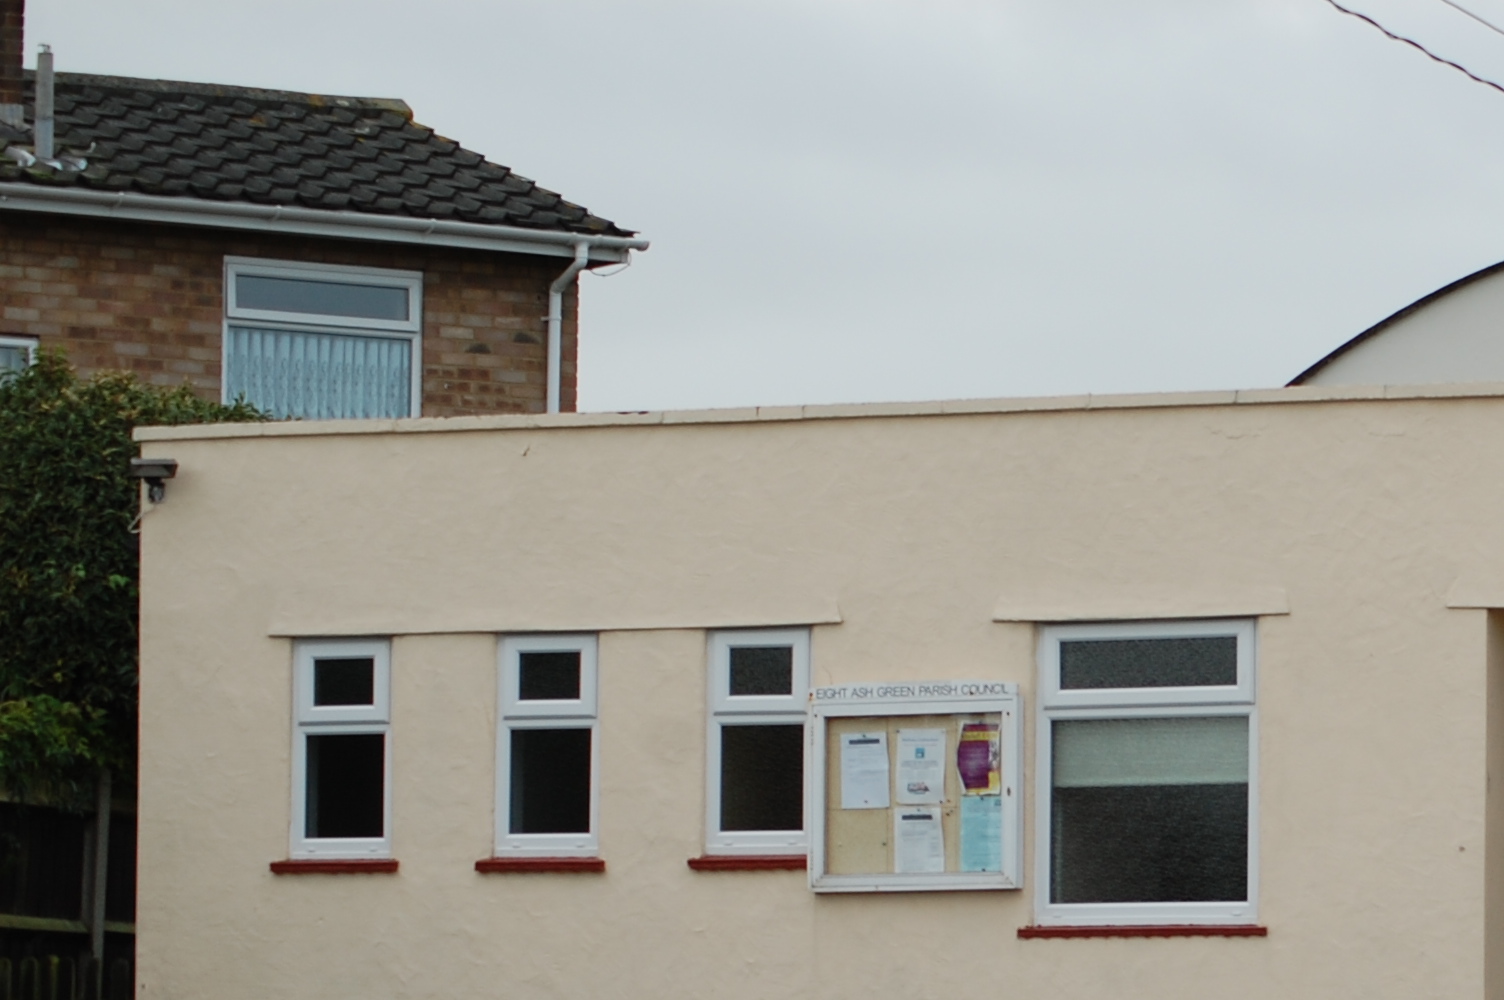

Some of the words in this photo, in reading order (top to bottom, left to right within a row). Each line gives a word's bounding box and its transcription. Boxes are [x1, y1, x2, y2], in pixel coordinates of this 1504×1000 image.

[816, 688, 848, 700] EIGHT
[851, 687, 874, 699] ASH
[877, 686, 915, 698] GREEN
[919, 685, 958, 697] PARISH
[961, 683, 1009, 696] COUNCIL
